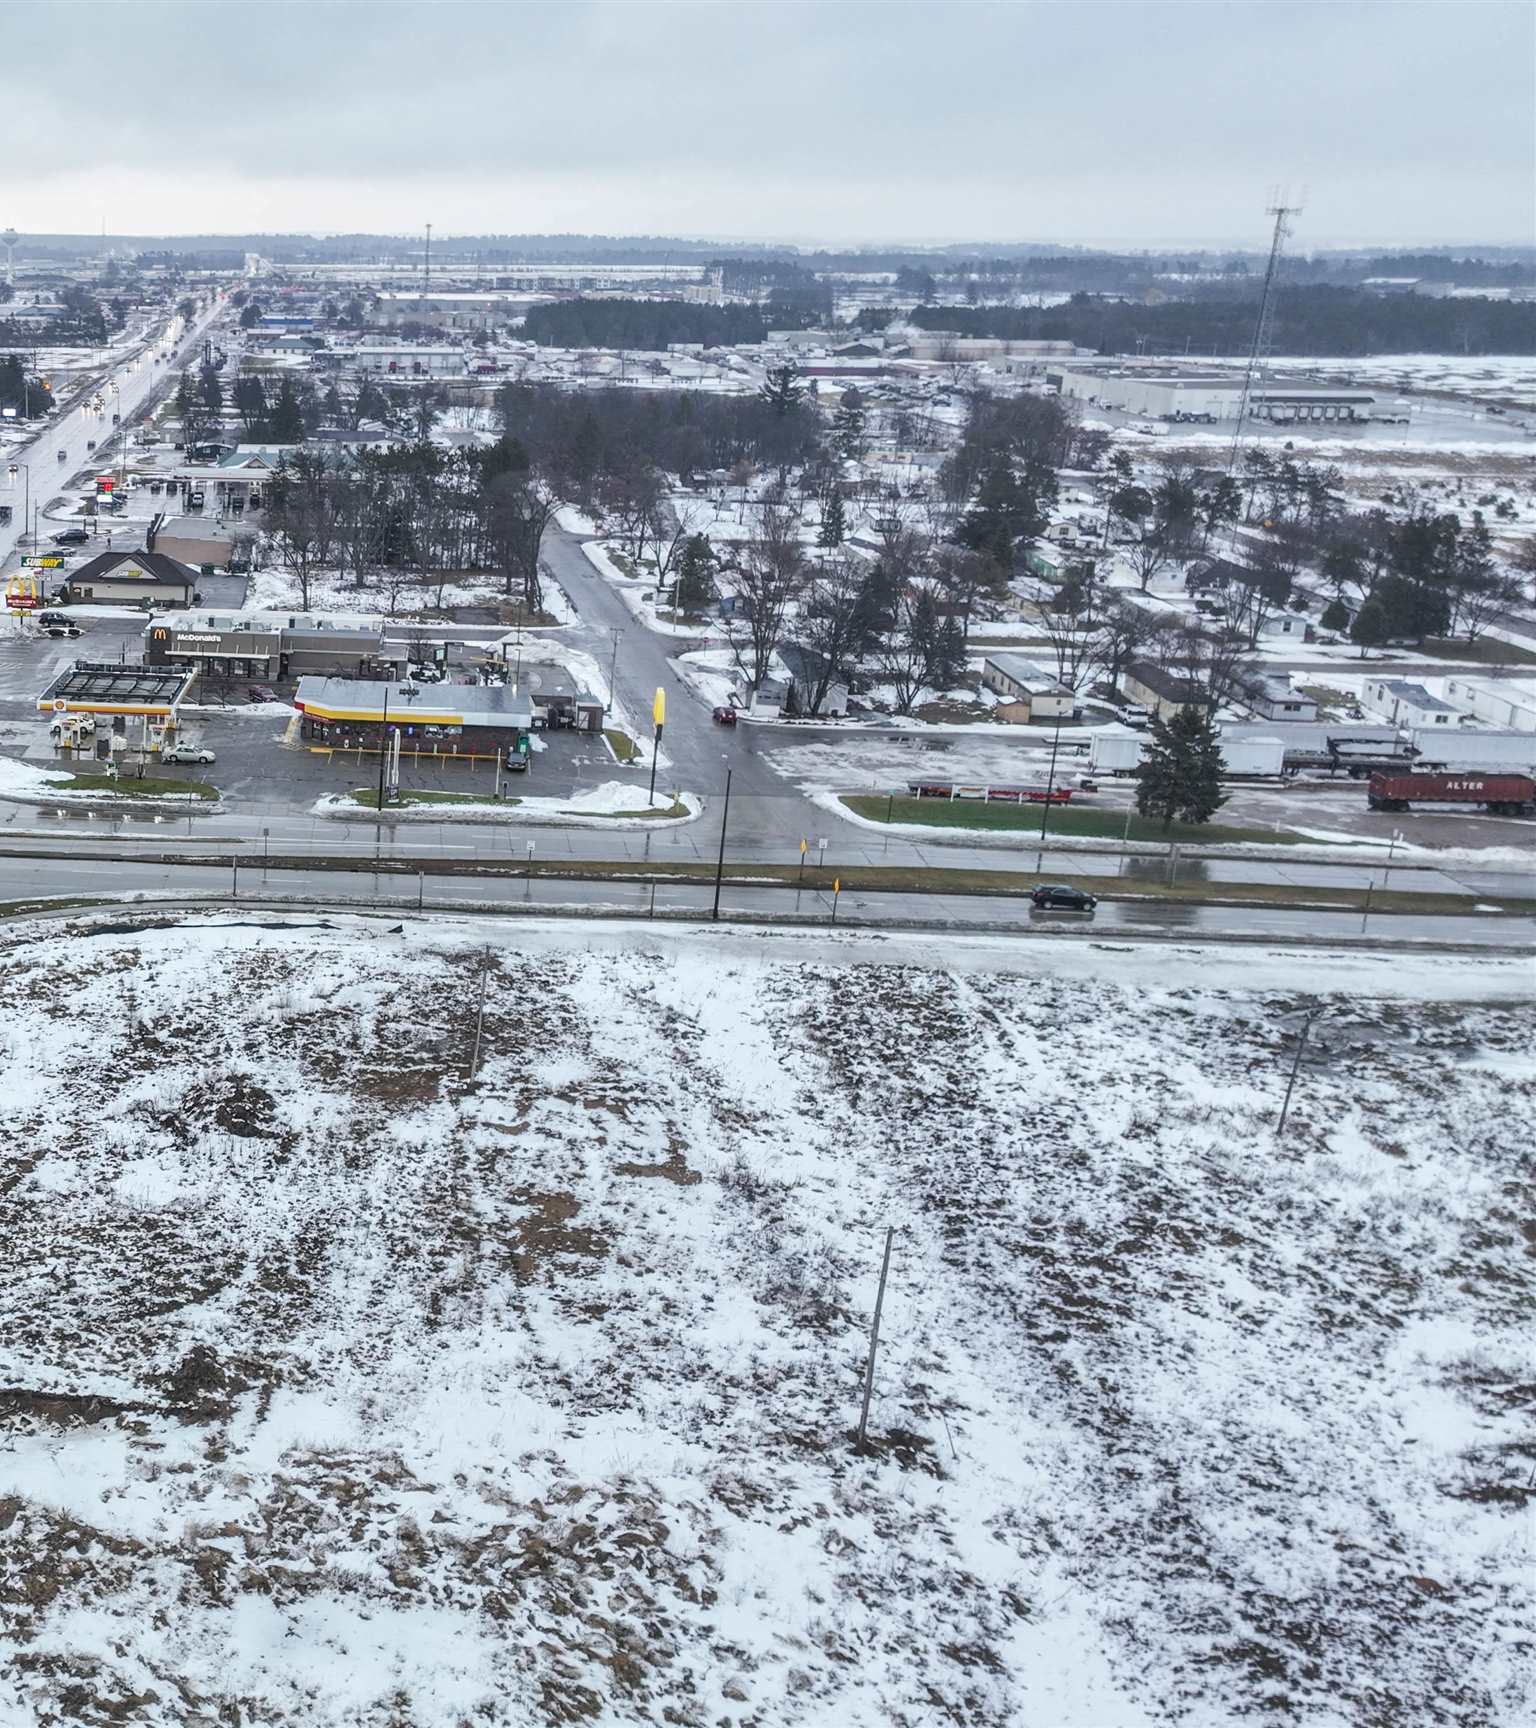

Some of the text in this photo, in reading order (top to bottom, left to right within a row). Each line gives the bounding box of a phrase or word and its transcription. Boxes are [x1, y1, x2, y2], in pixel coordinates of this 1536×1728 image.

[23, 556, 63, 568] SUBWAY
[177, 633, 222, 643] McDonald's
[1446, 781, 1485, 790] ALTER
